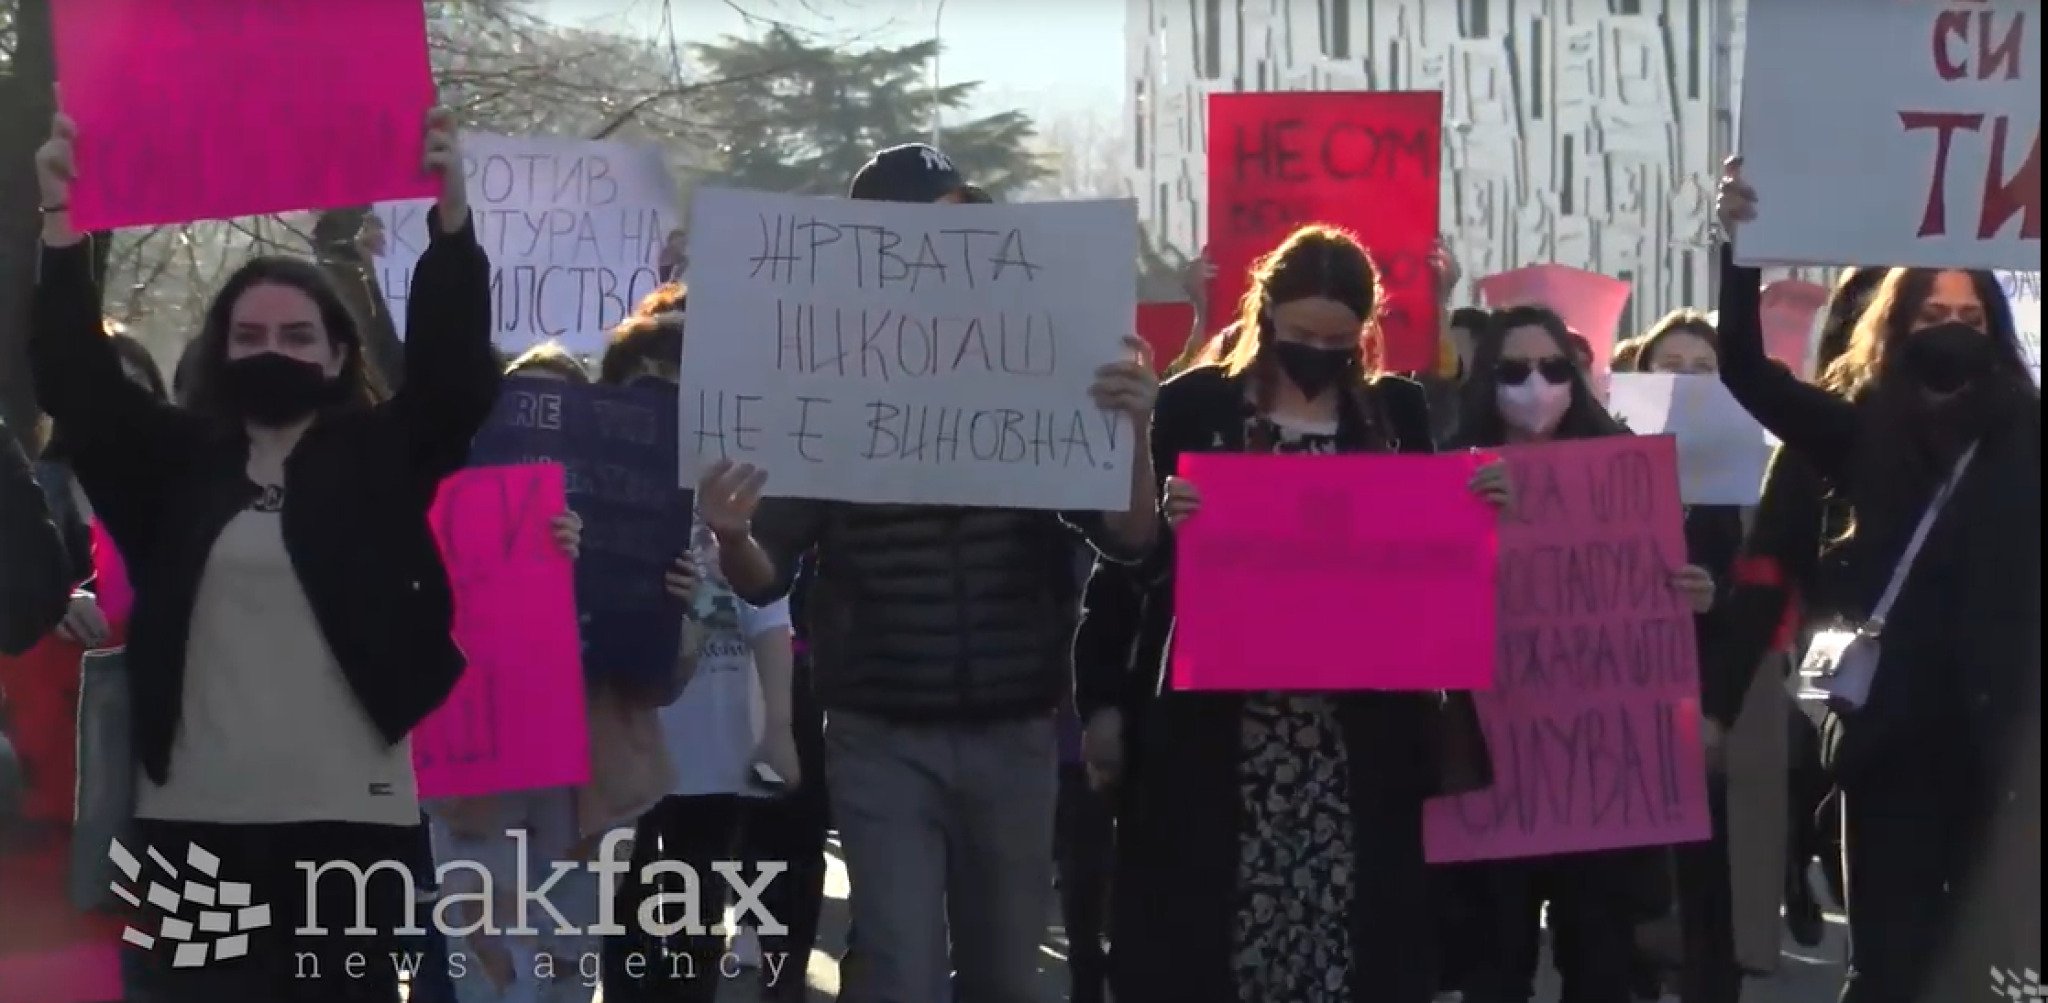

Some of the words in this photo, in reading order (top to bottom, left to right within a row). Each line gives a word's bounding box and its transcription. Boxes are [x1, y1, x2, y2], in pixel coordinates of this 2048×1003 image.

[1932, 9, 2025, 81] СИ
[1232, 117, 1309, 184] НЕ
[749, 211, 1042, 292] ЖРТВАТА
[776, 299, 1056, 382] НИКОГАШ
[692, 390, 764, 460] НЕ
[788, 397, 833, 463] Е
